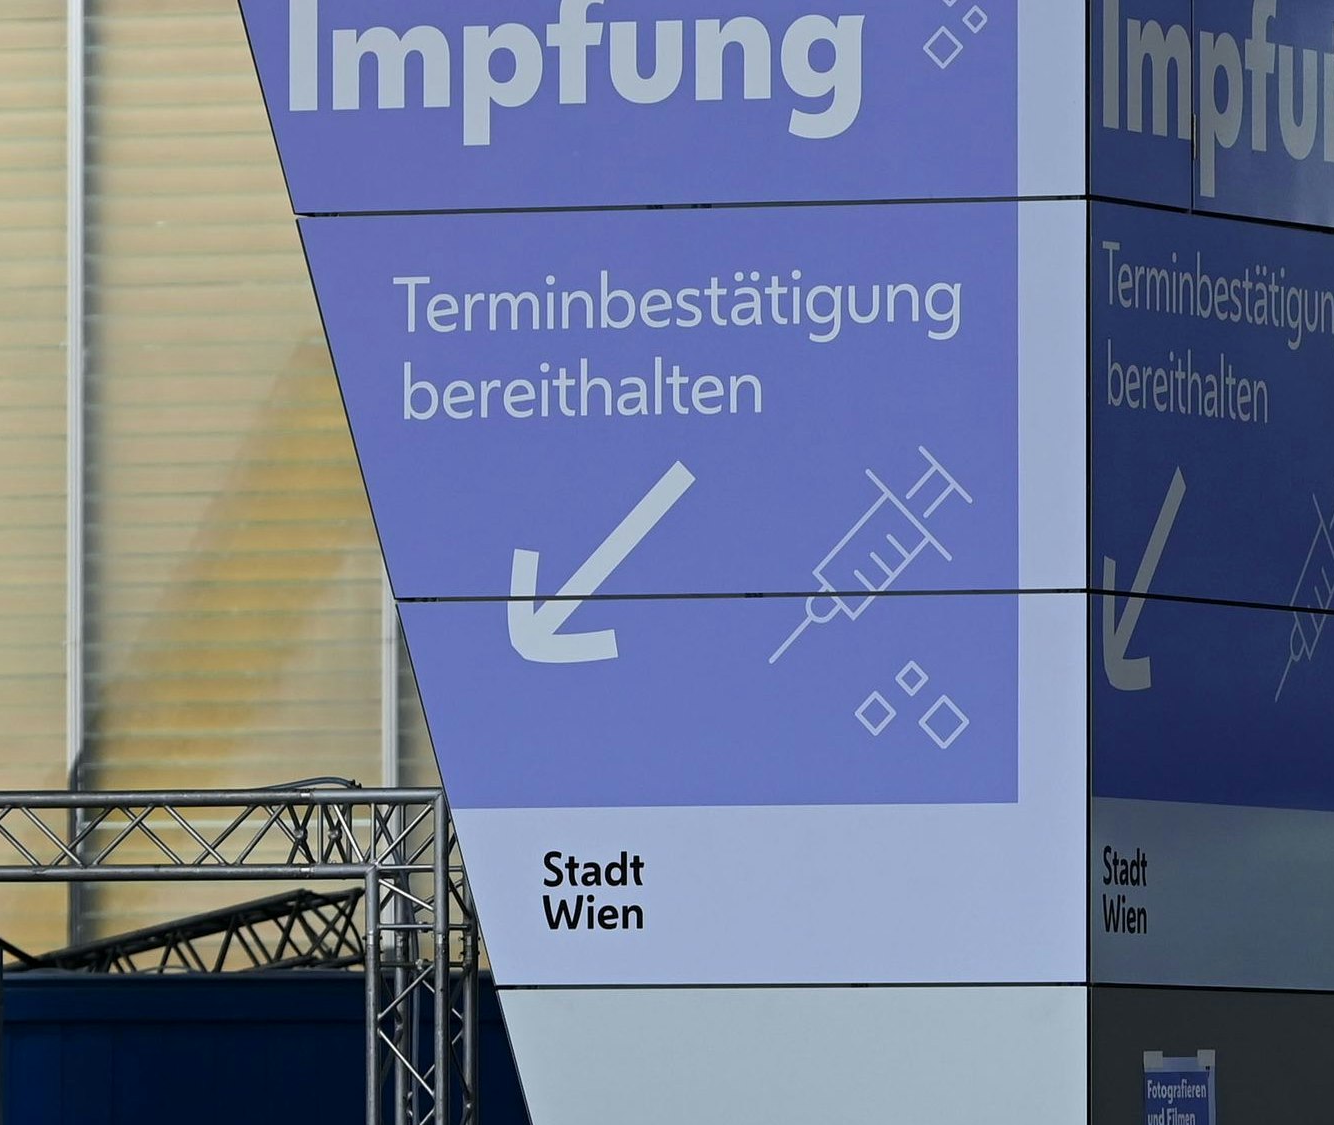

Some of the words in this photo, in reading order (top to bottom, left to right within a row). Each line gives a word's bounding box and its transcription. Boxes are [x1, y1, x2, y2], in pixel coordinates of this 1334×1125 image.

[288, 0, 865, 146] Impfung
[393, 269, 963, 343] Terminbestätigung
[402, 357, 763, 420] bereithalten
[1107, 338, 1268, 423] bereithalten
[543, 850, 645, 887] Stadt
[1103, 845, 1148, 887] Stadt
[542, 894, 644, 930] Wien
[1102, 894, 1148, 934] Wien
[1147, 1079, 1207, 1104] Fotografieren
